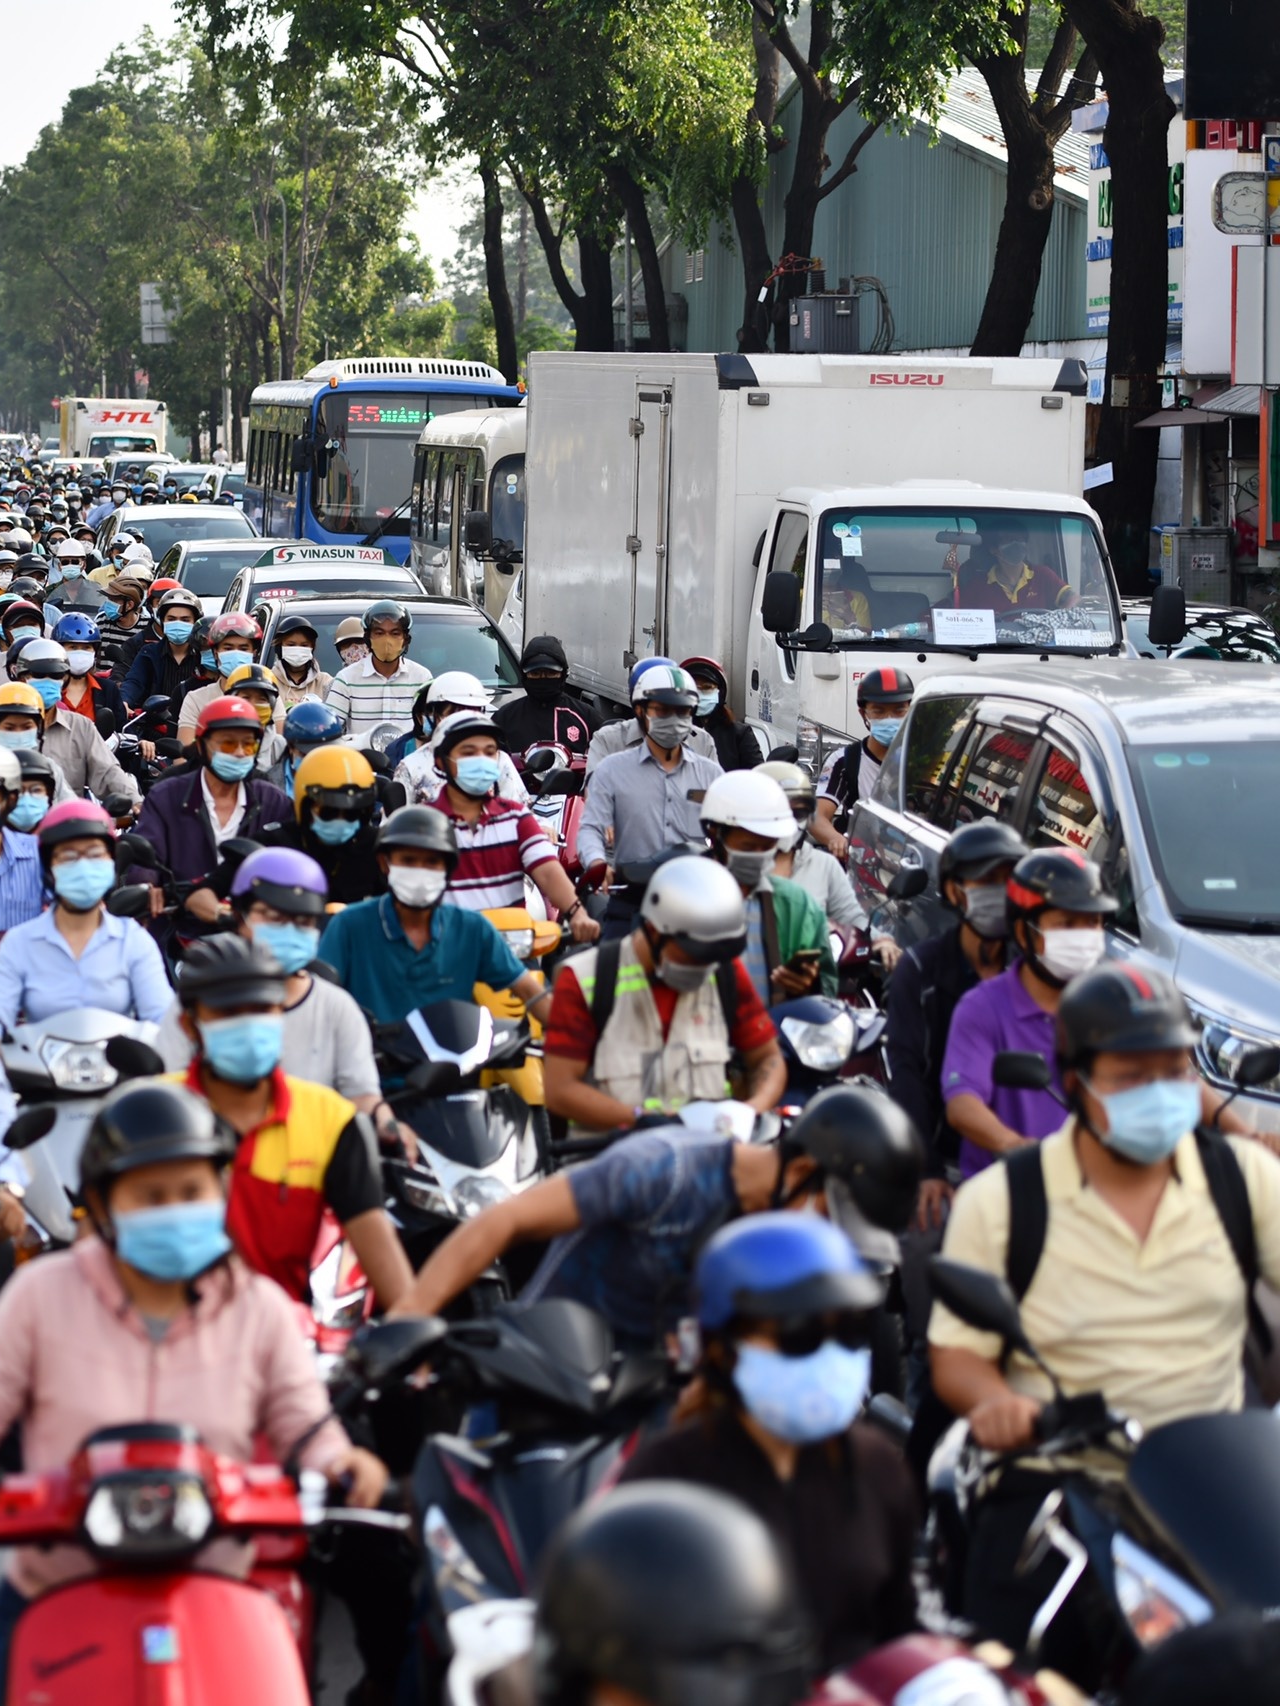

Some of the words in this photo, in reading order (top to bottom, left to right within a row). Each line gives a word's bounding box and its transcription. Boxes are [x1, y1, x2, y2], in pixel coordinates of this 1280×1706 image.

[869, 373, 944, 386] ISUZU
[101, 411, 154, 423] HTL
[300, 549, 355, 559] VINASUN
[358, 550, 382, 560] TAXI
